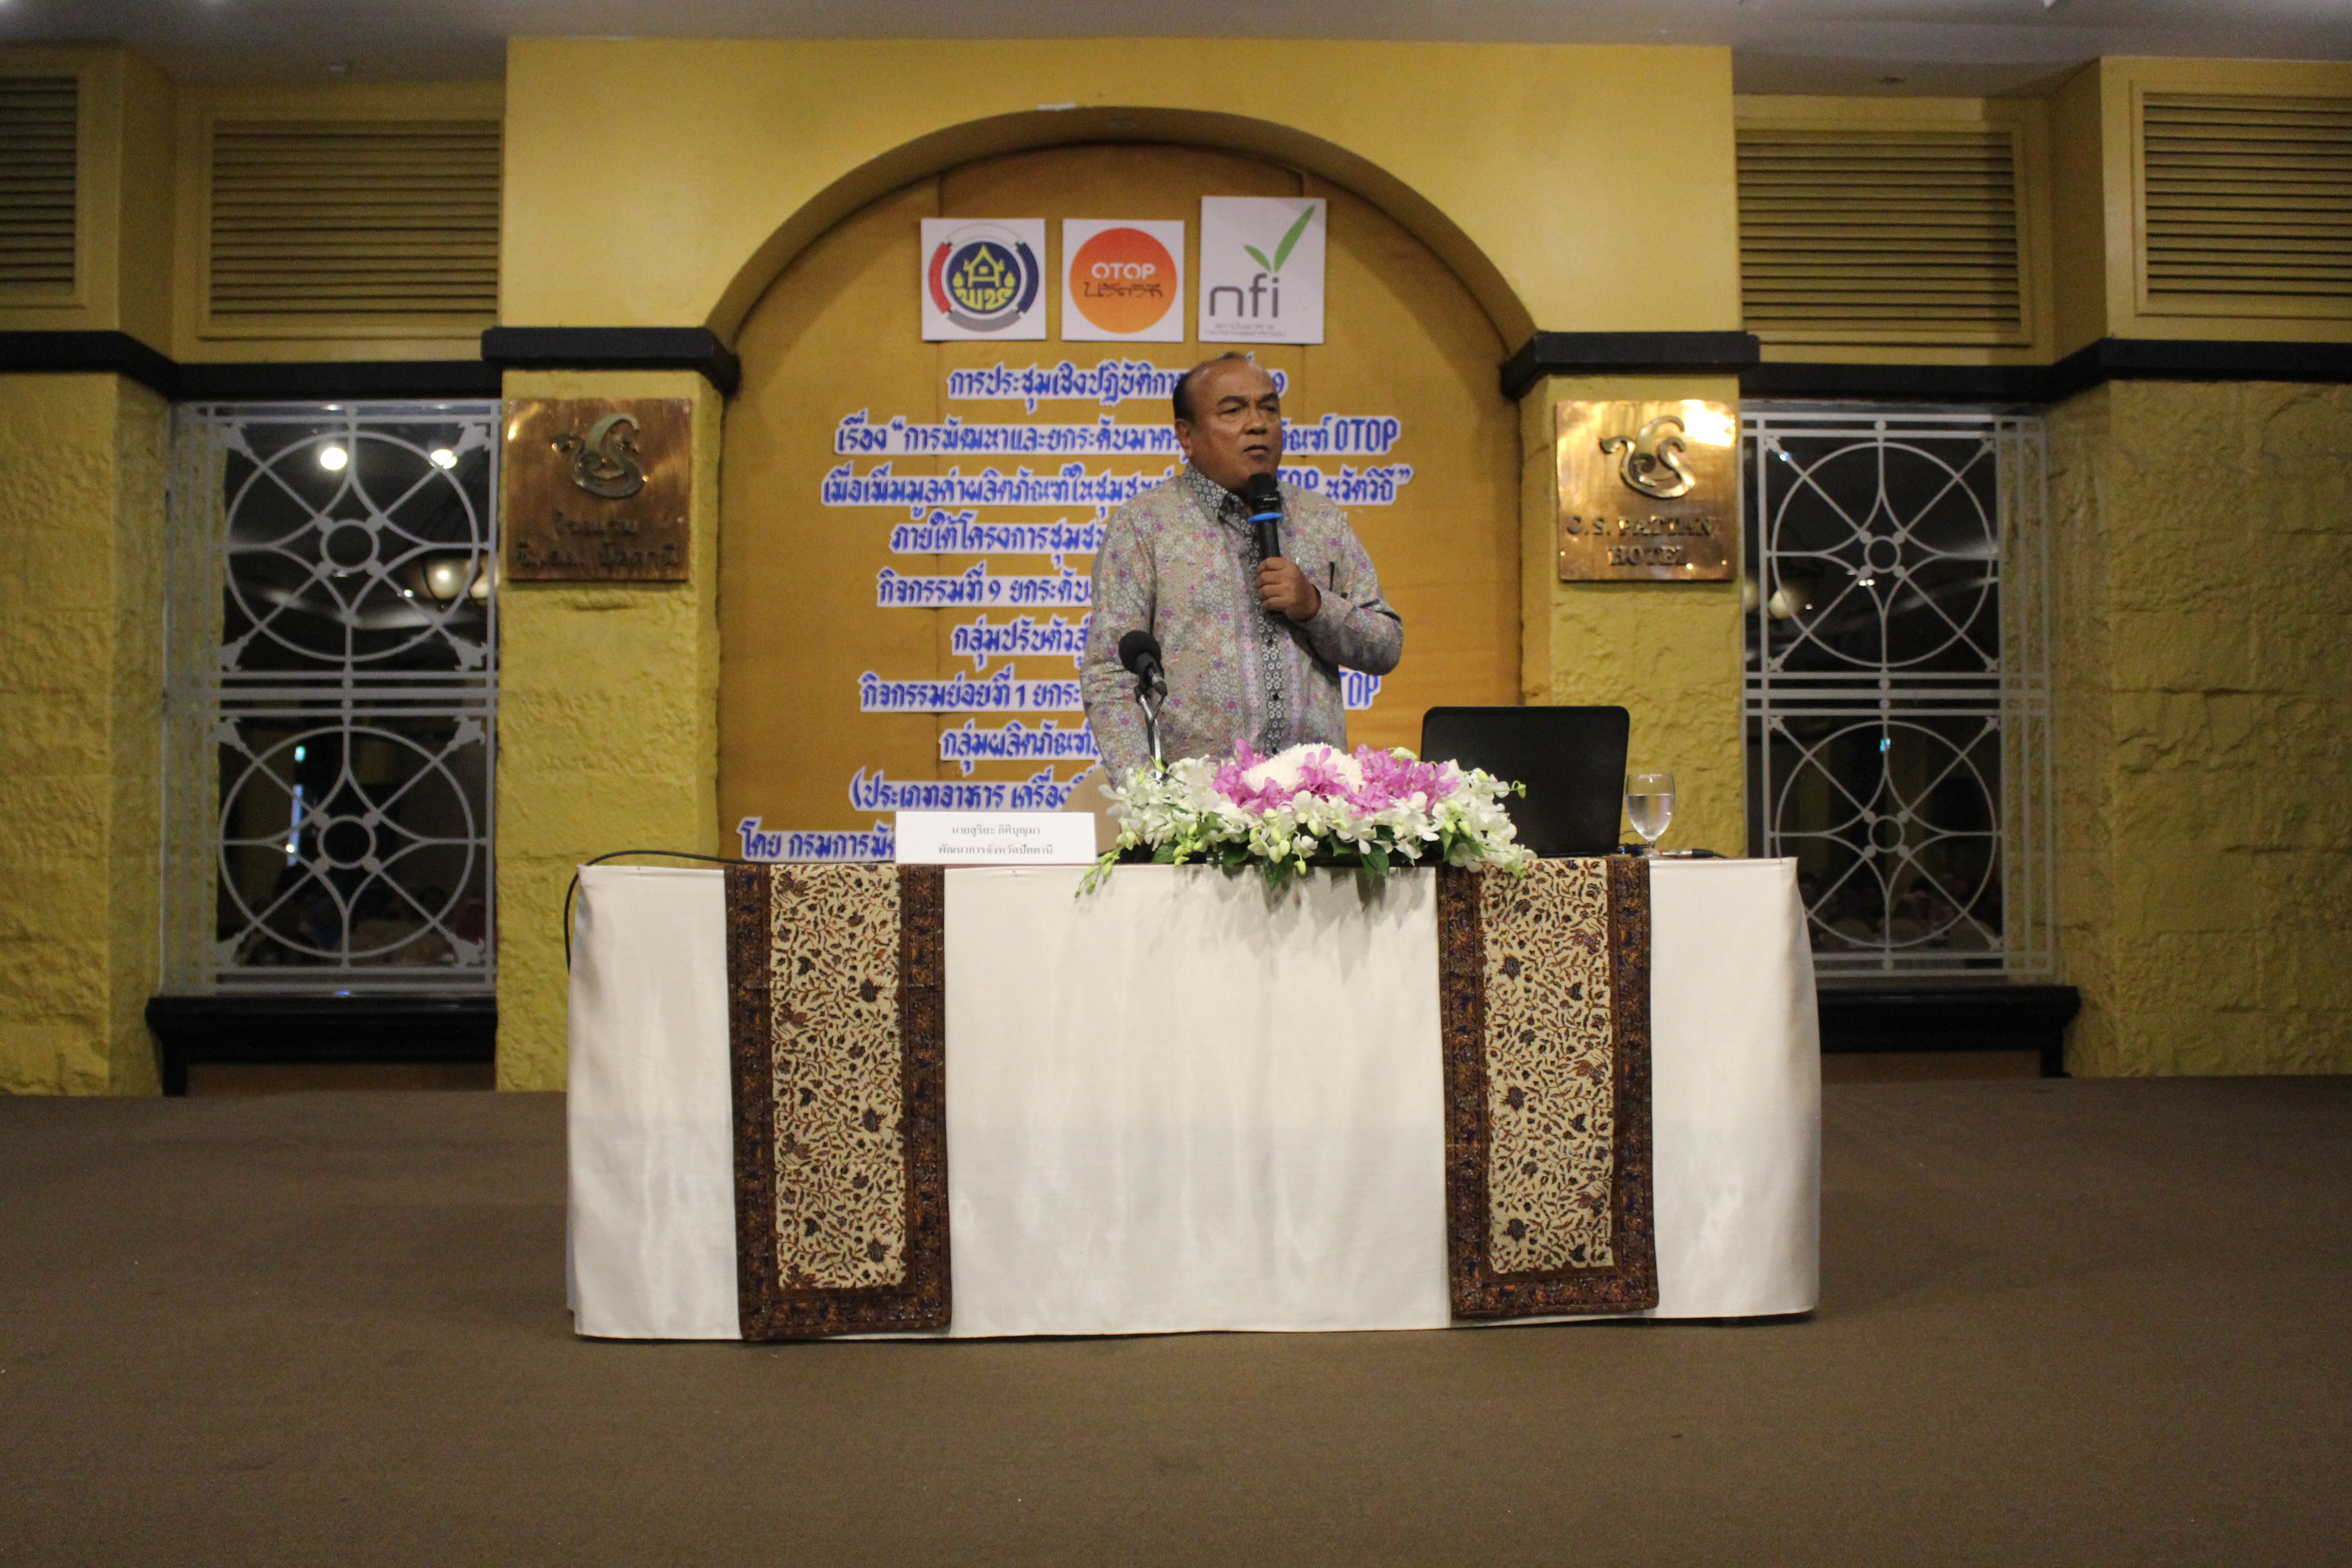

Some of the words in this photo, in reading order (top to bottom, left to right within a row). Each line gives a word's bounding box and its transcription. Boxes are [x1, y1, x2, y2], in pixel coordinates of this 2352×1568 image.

[1091, 262, 1156, 280] OTOP
[1209, 272, 1279, 318] nfi
[949, 361, 1186, 411] การประชุมเชิงปฏิบัติกา
[838, 410, 888, 452] เรื่อง
[1334, 418, 1399, 452] OTOP
[1015, 684, 1026, 708] 1
[740, 820, 782, 858] โดย
